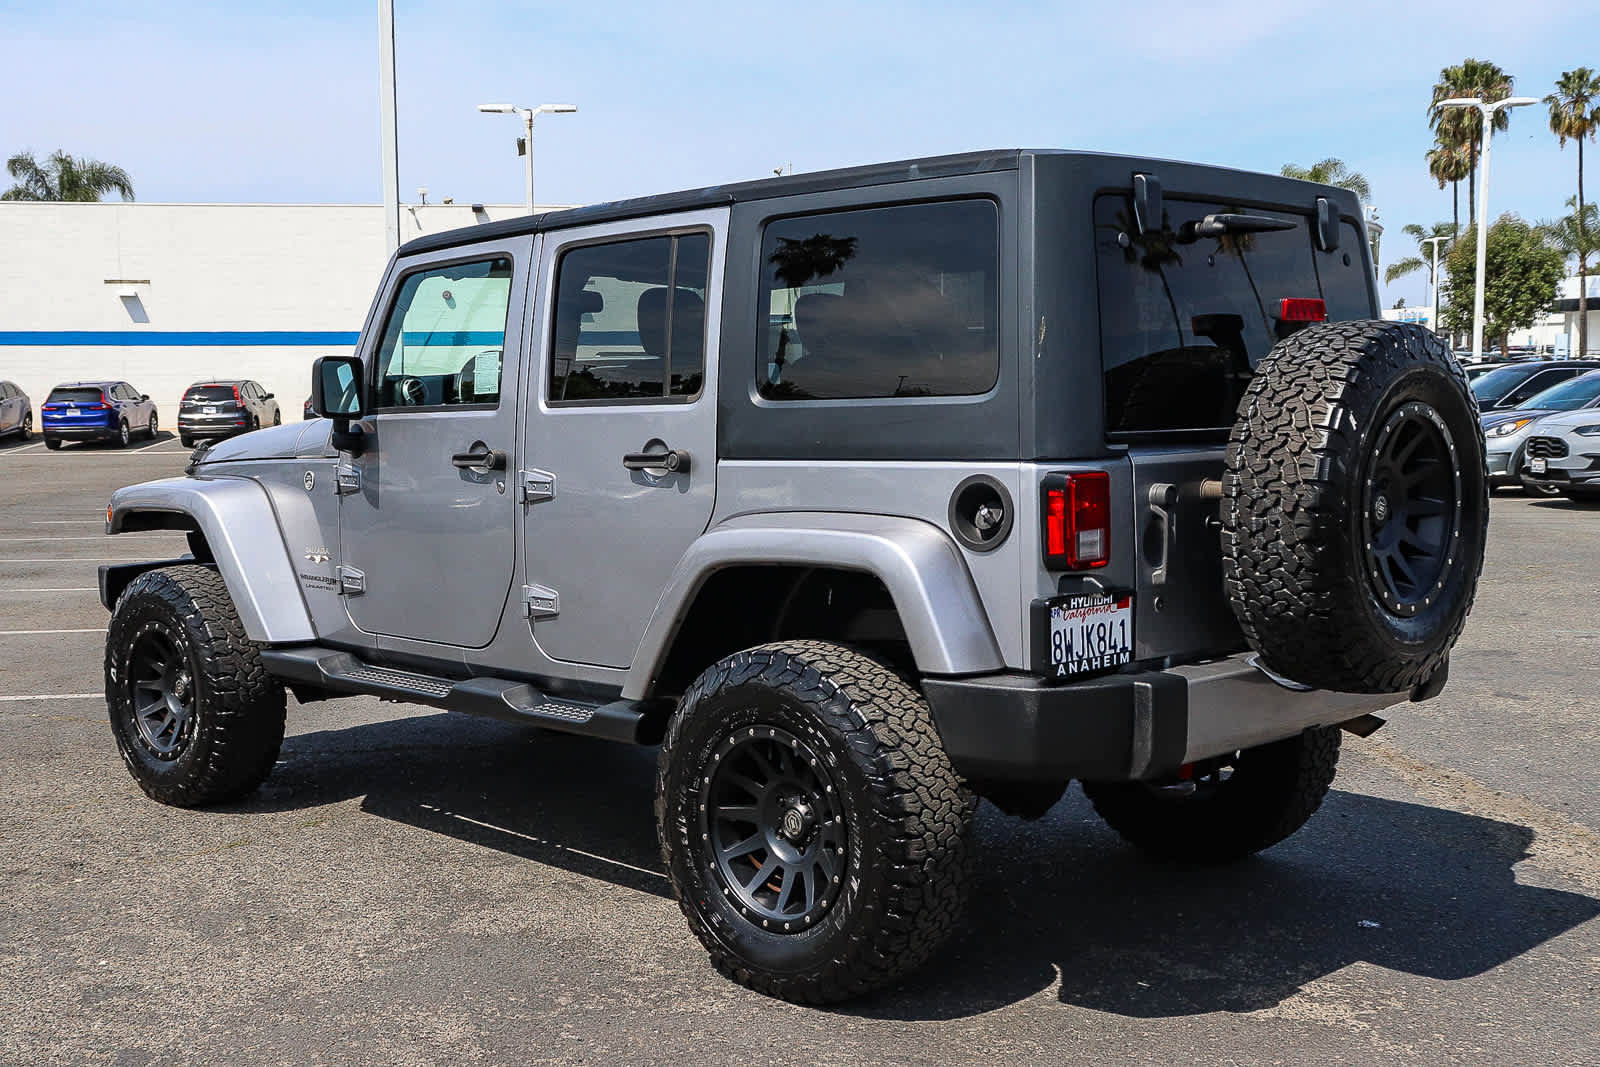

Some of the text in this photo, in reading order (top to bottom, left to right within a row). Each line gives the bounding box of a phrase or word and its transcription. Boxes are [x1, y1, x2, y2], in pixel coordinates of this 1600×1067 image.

[1070, 594, 1113, 609] HYUNDAI
[1063, 605, 1118, 623] California
[1053, 619, 1128, 663] 8WJK841
[1056, 652, 1130, 676] ANAHEIM
